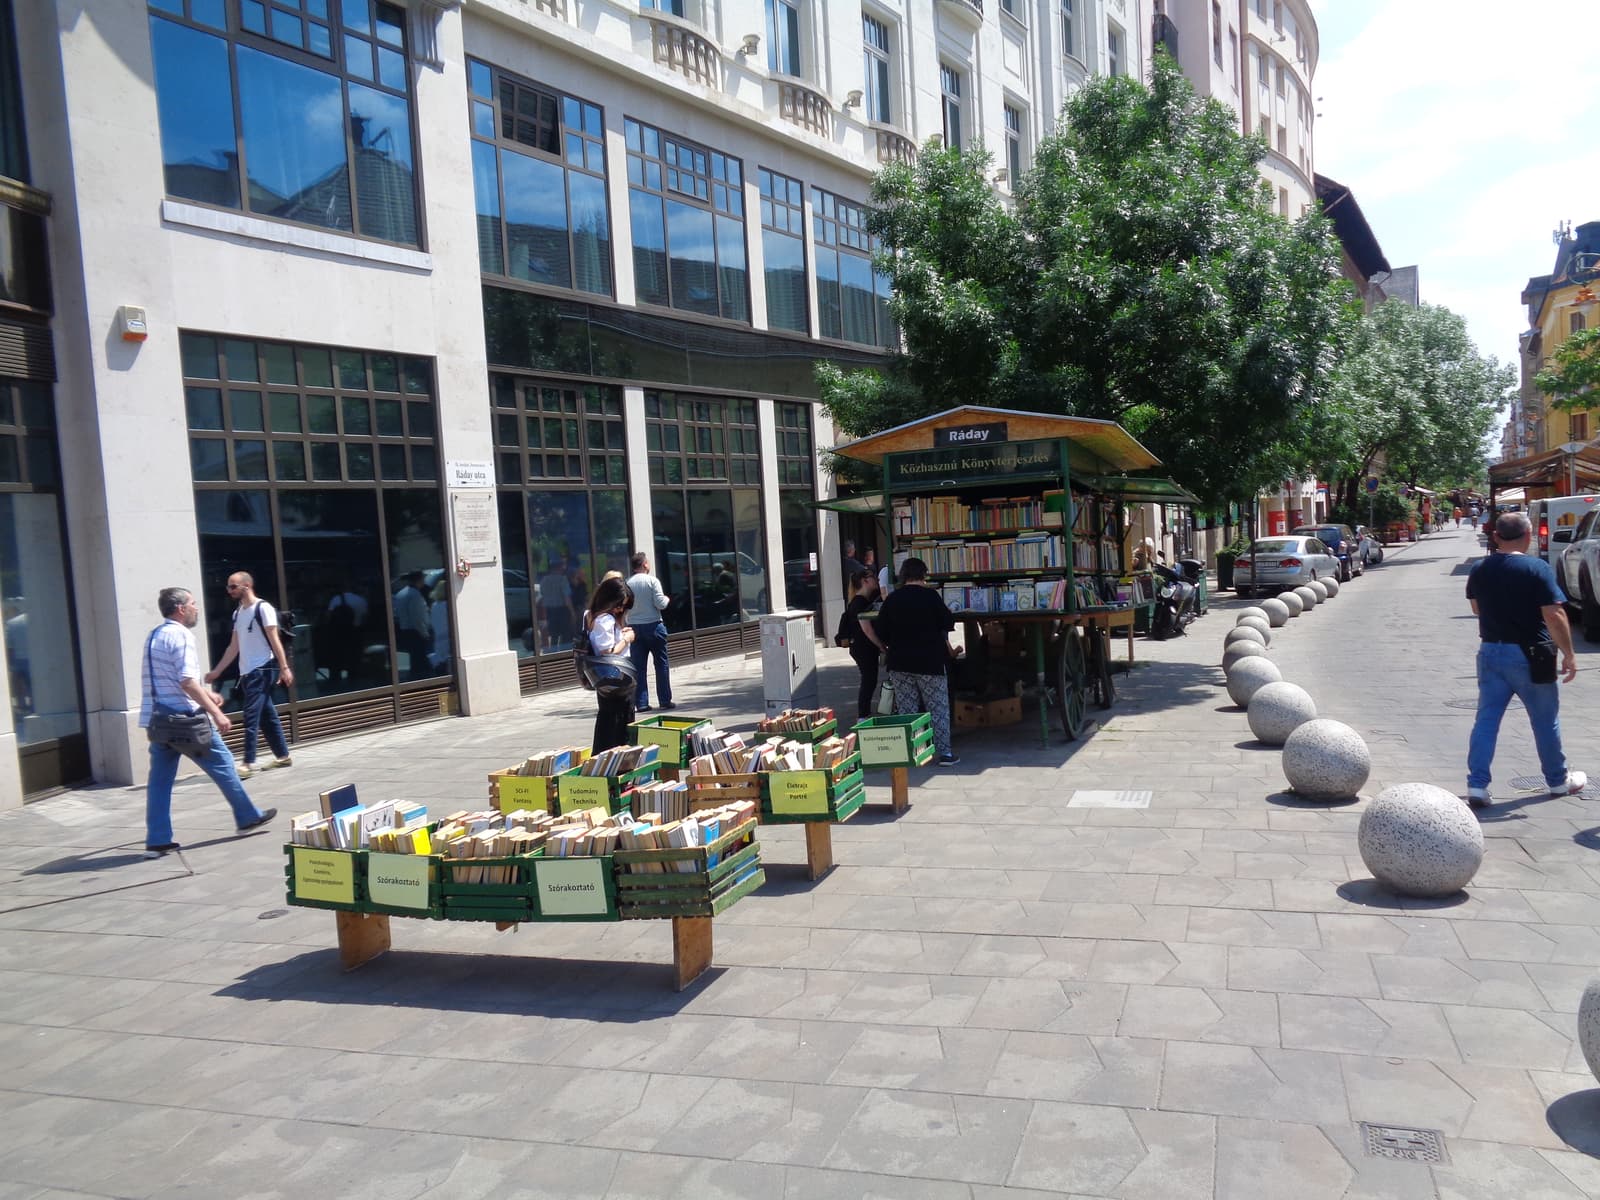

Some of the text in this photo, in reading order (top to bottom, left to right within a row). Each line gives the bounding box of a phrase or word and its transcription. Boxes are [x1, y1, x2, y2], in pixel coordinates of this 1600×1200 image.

[949, 429, 990, 441] Ráday
[899, 453, 1049, 475] Közhasznú Könyvterjesztés
[569, 787, 598, 796] Tudomány
[376, 875, 420, 887] Szórakoztató
[547, 883, 595, 893] Szórakoztató
